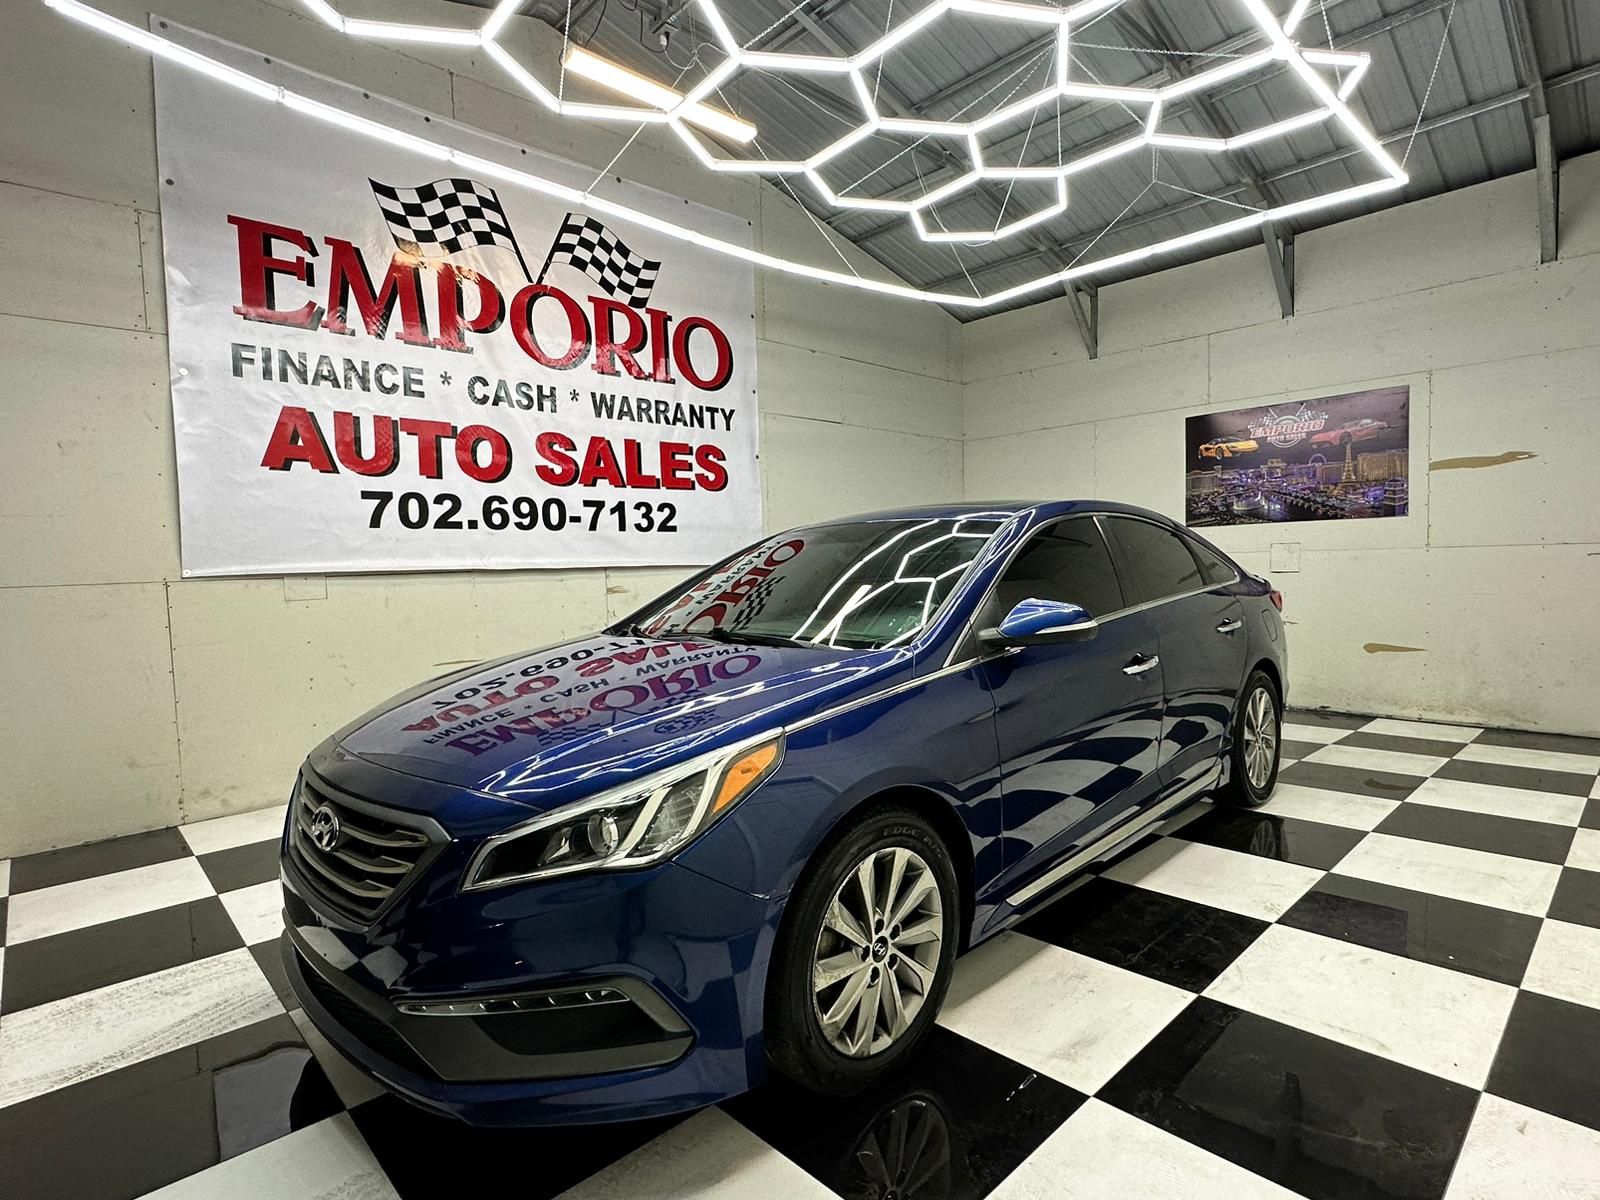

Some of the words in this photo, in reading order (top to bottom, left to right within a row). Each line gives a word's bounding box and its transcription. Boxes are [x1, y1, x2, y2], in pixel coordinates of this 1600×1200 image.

[227, 214, 734, 391] EMPORIO
[231, 342, 426, 399] FINANCE
[467, 376, 558, 413] CASH
[590, 390, 736, 431] WARRANTY
[1250, 419, 1325, 438] EMPORIO
[261, 405, 513, 484] AUTO
[535, 432, 729, 491] SALES
[360, 490, 678, 533] 702.690-7132
